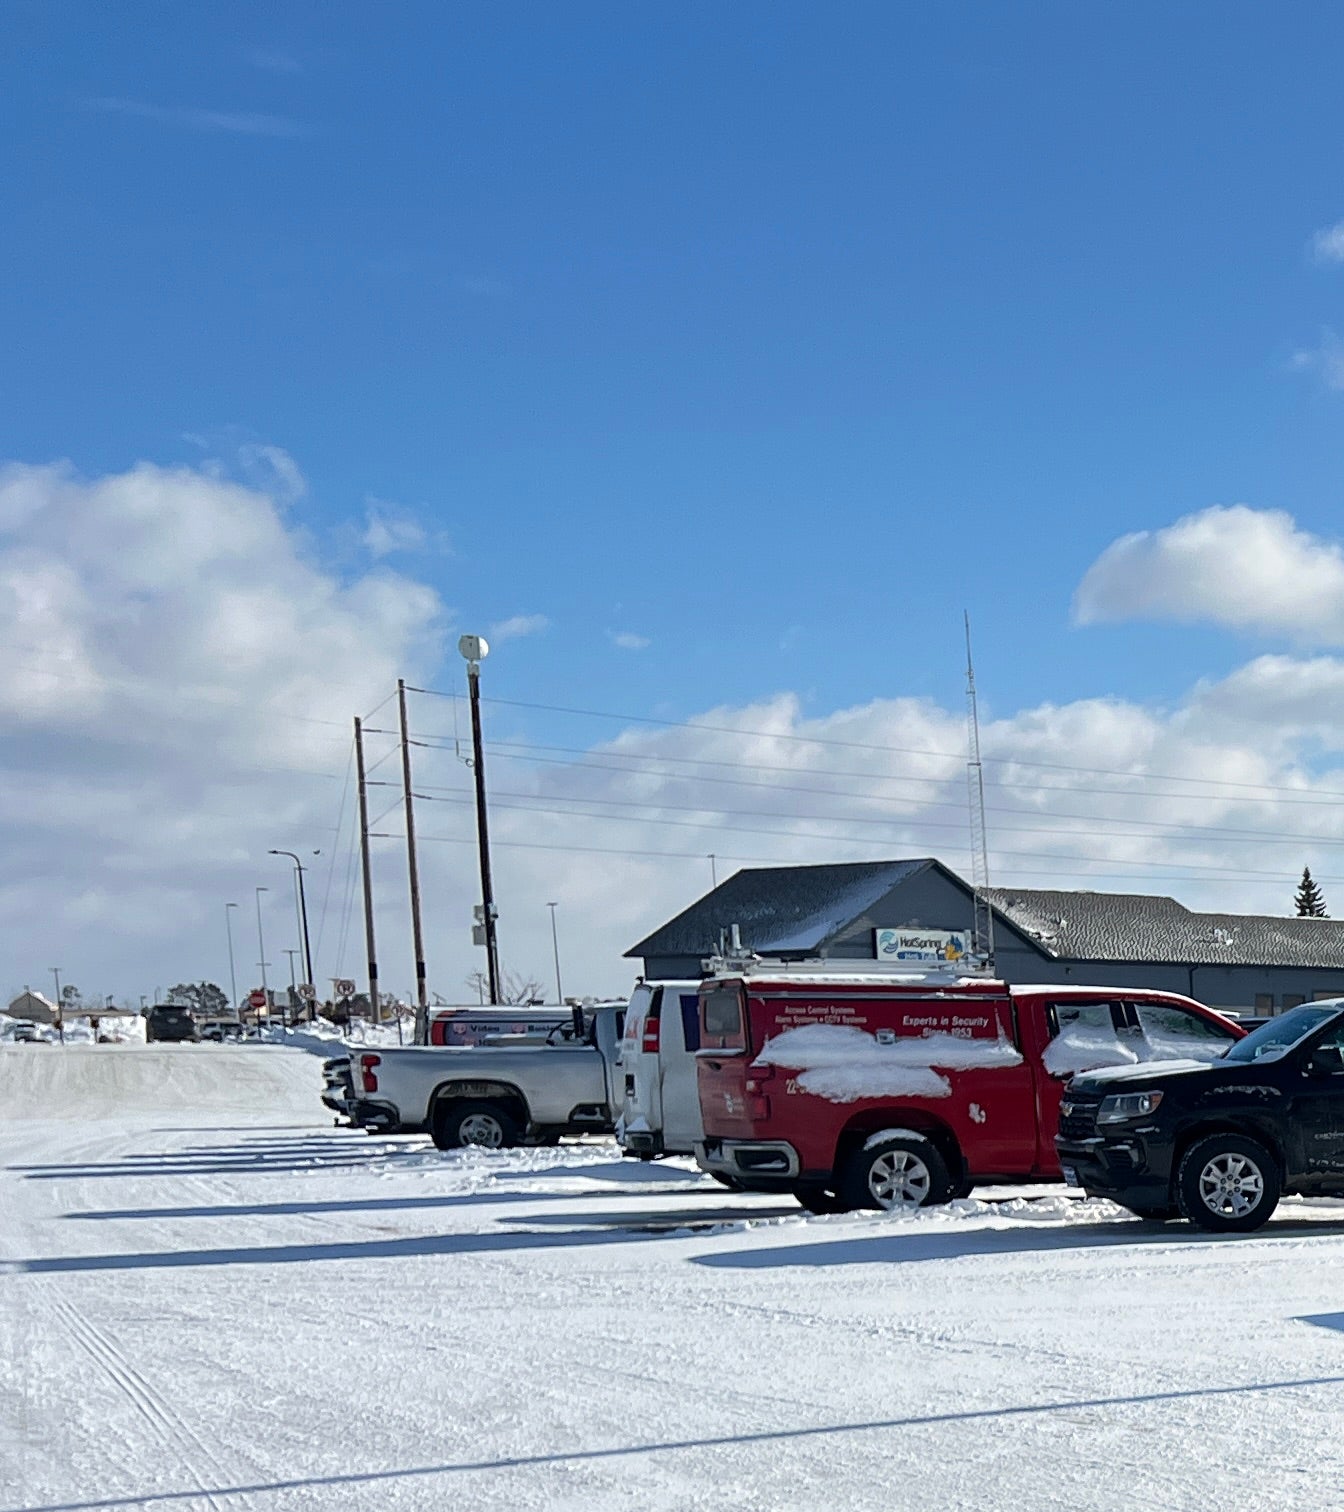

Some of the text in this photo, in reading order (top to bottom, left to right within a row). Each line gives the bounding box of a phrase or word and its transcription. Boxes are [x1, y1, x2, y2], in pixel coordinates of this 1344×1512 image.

[902, 1015, 989, 1028] Experts in Security
